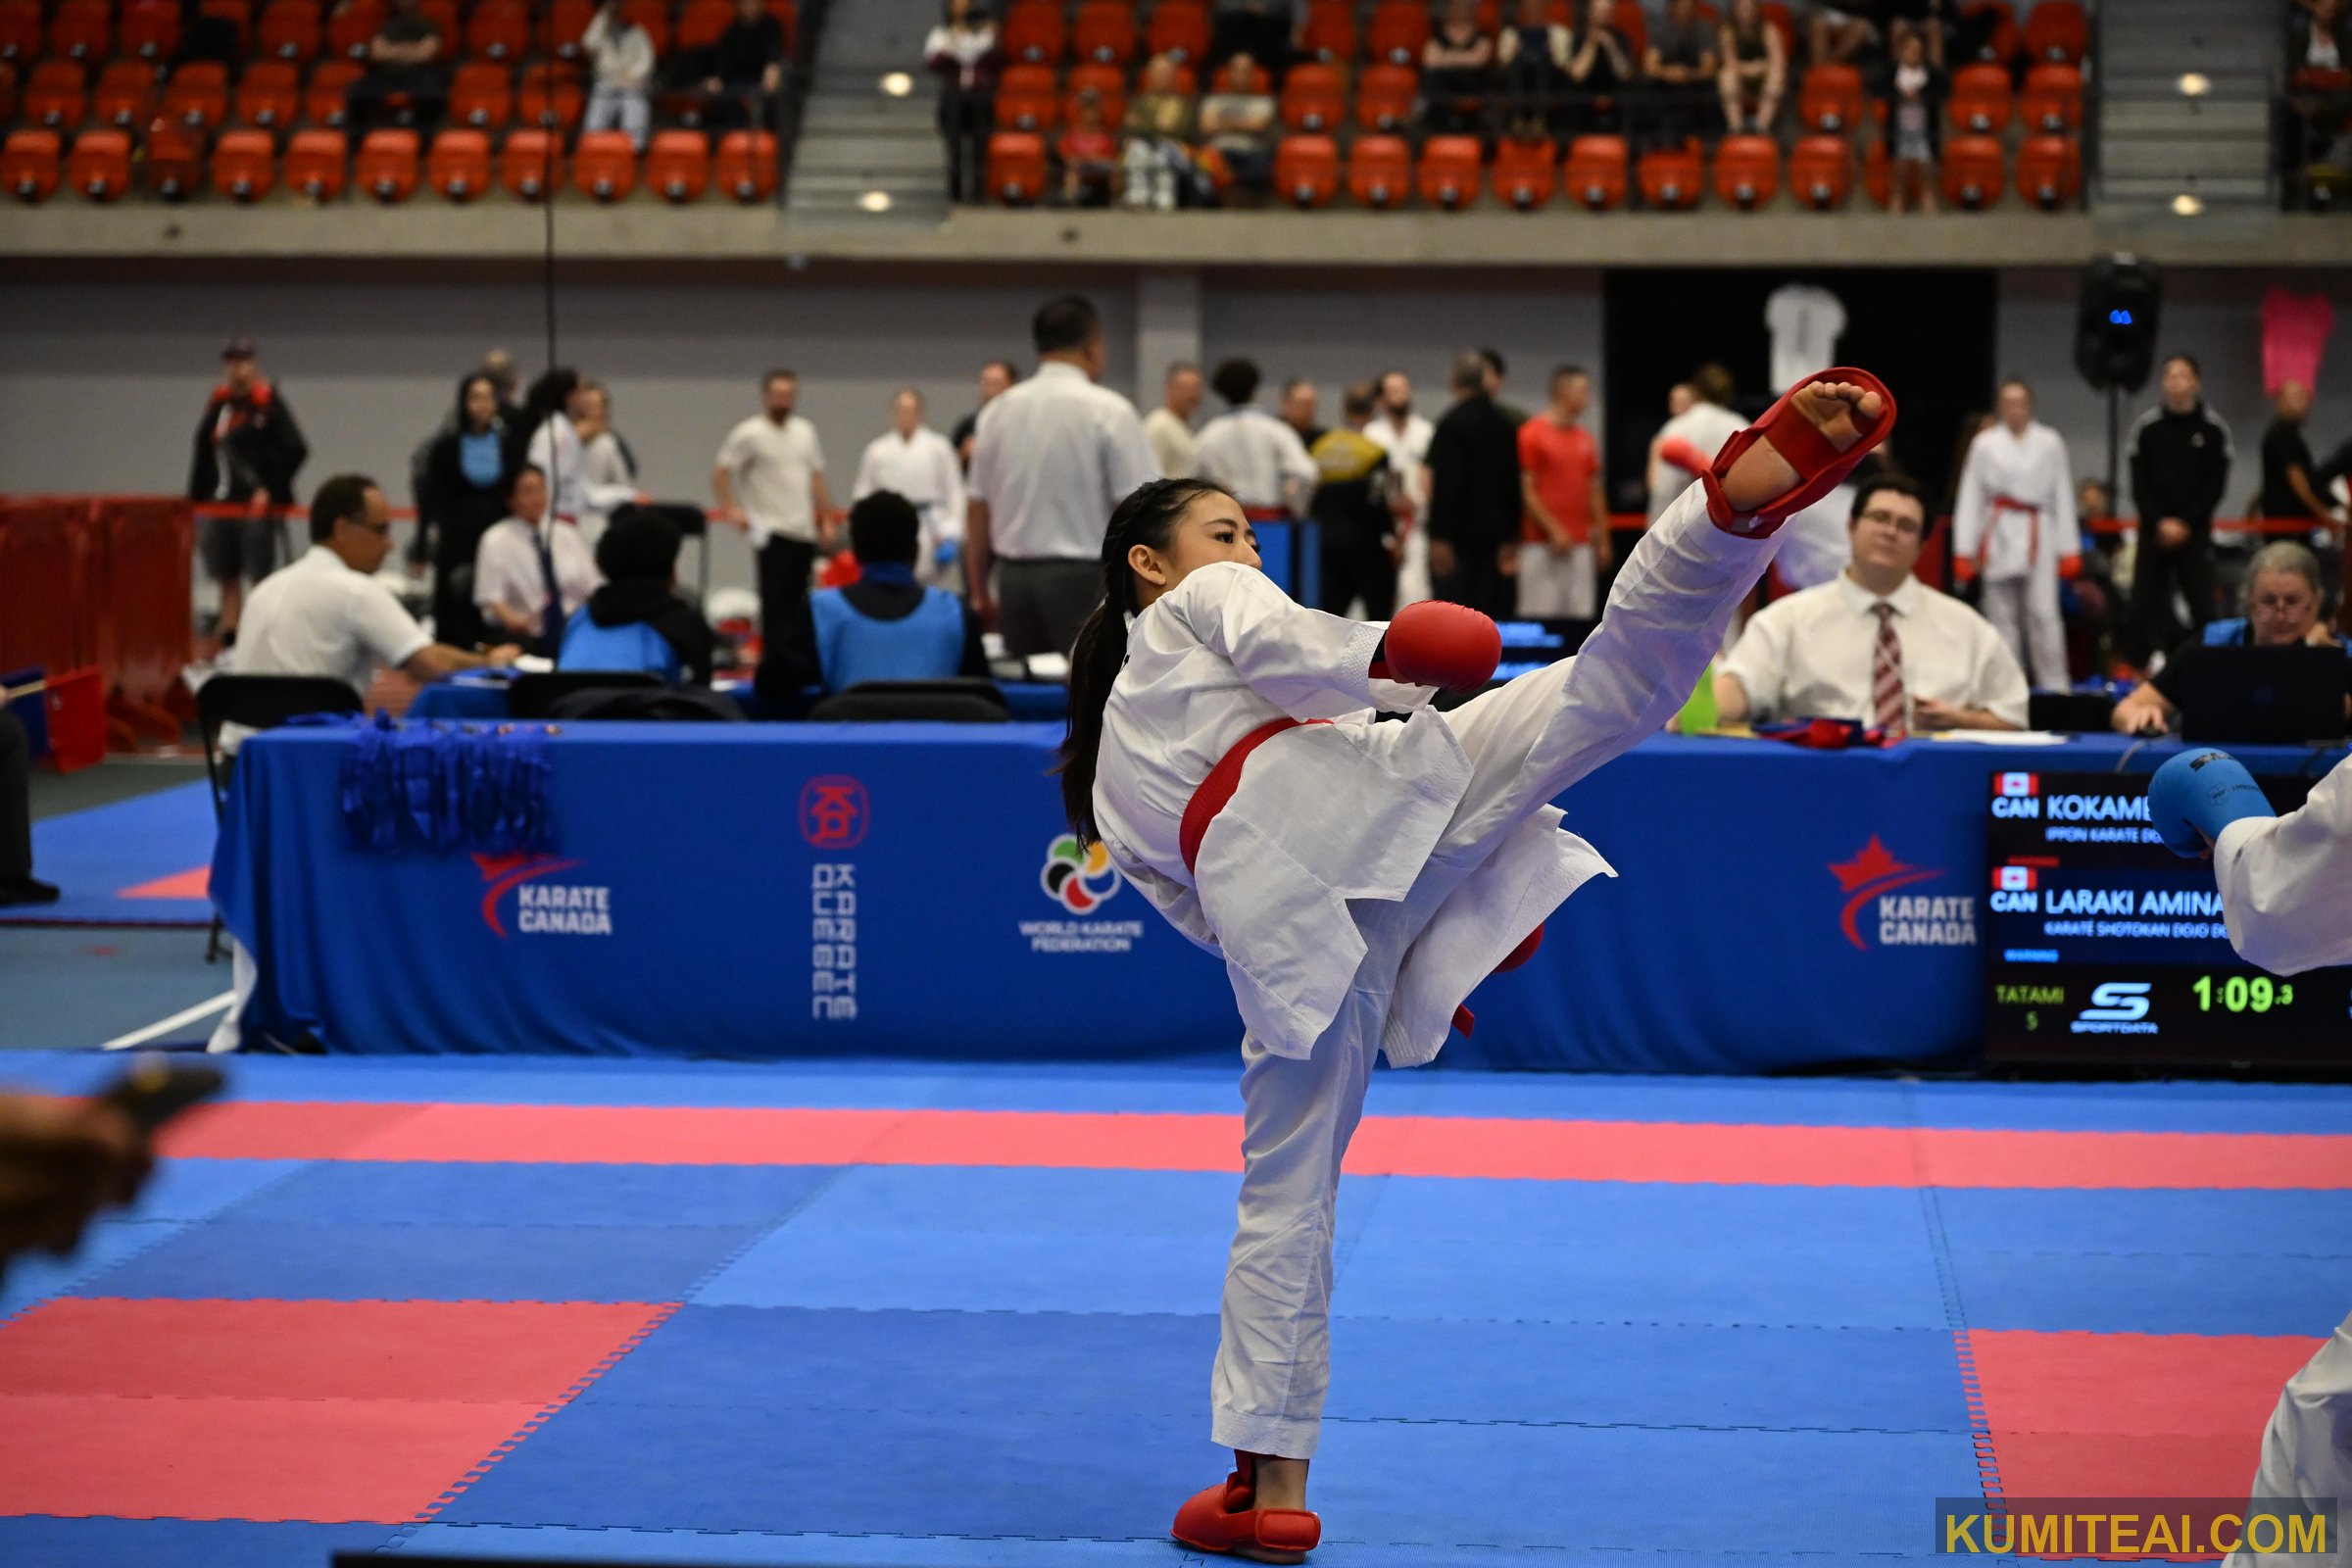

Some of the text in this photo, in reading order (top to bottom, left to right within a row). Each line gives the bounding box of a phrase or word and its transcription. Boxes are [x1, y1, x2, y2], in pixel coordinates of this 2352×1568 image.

[1991, 796, 2039, 818] CAN
[2089, 826, 2139, 843] KARATE
[518, 885, 611, 909] KARATE
[1990, 891, 2038, 912] CAN
[2045, 888, 2134, 915] LARAKI
[1879, 896, 1975, 920] KARATE
[518, 908, 612, 935] CANADA
[1018, 920, 1144, 938] WORLD KARATE
[2096, 921, 2171, 938] SHOTOKAN
[1879, 919, 1978, 946] CANADA
[1031, 937, 1132, 953] FEDERATION
[1996, 985, 2066, 1004] TATAMI
[2070, 1020, 2159, 1034] SPORTDATA
